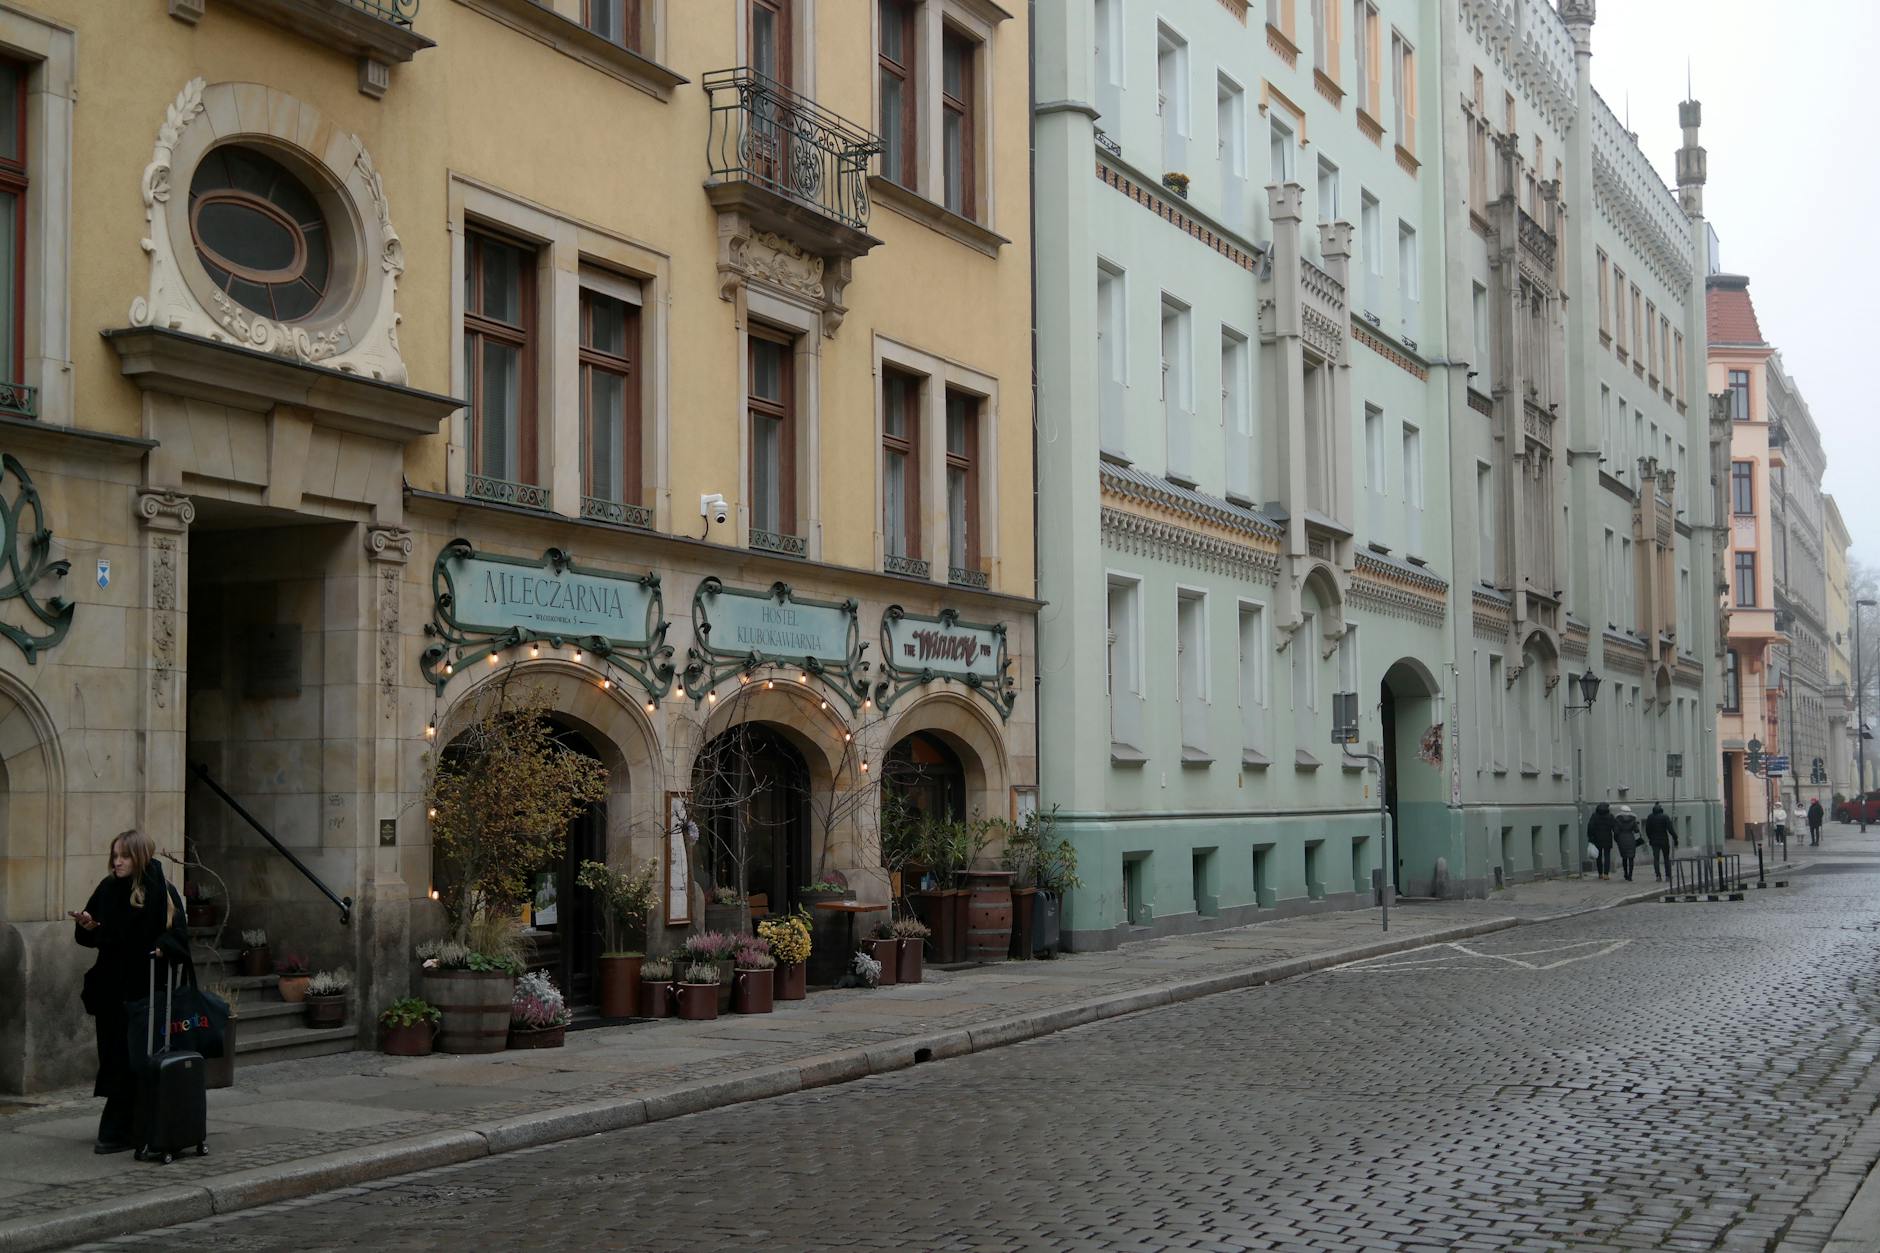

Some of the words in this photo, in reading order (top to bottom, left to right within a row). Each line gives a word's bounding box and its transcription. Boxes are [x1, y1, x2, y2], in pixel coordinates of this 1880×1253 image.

[484, 570, 624, 619] MLECZARNIA
[762, 606, 799, 627] HOSTEL
[737, 626, 821, 651] KLUBOKAWIARNIA
[903, 643, 916, 657] THE
[980, 644, 991, 657] PUB
